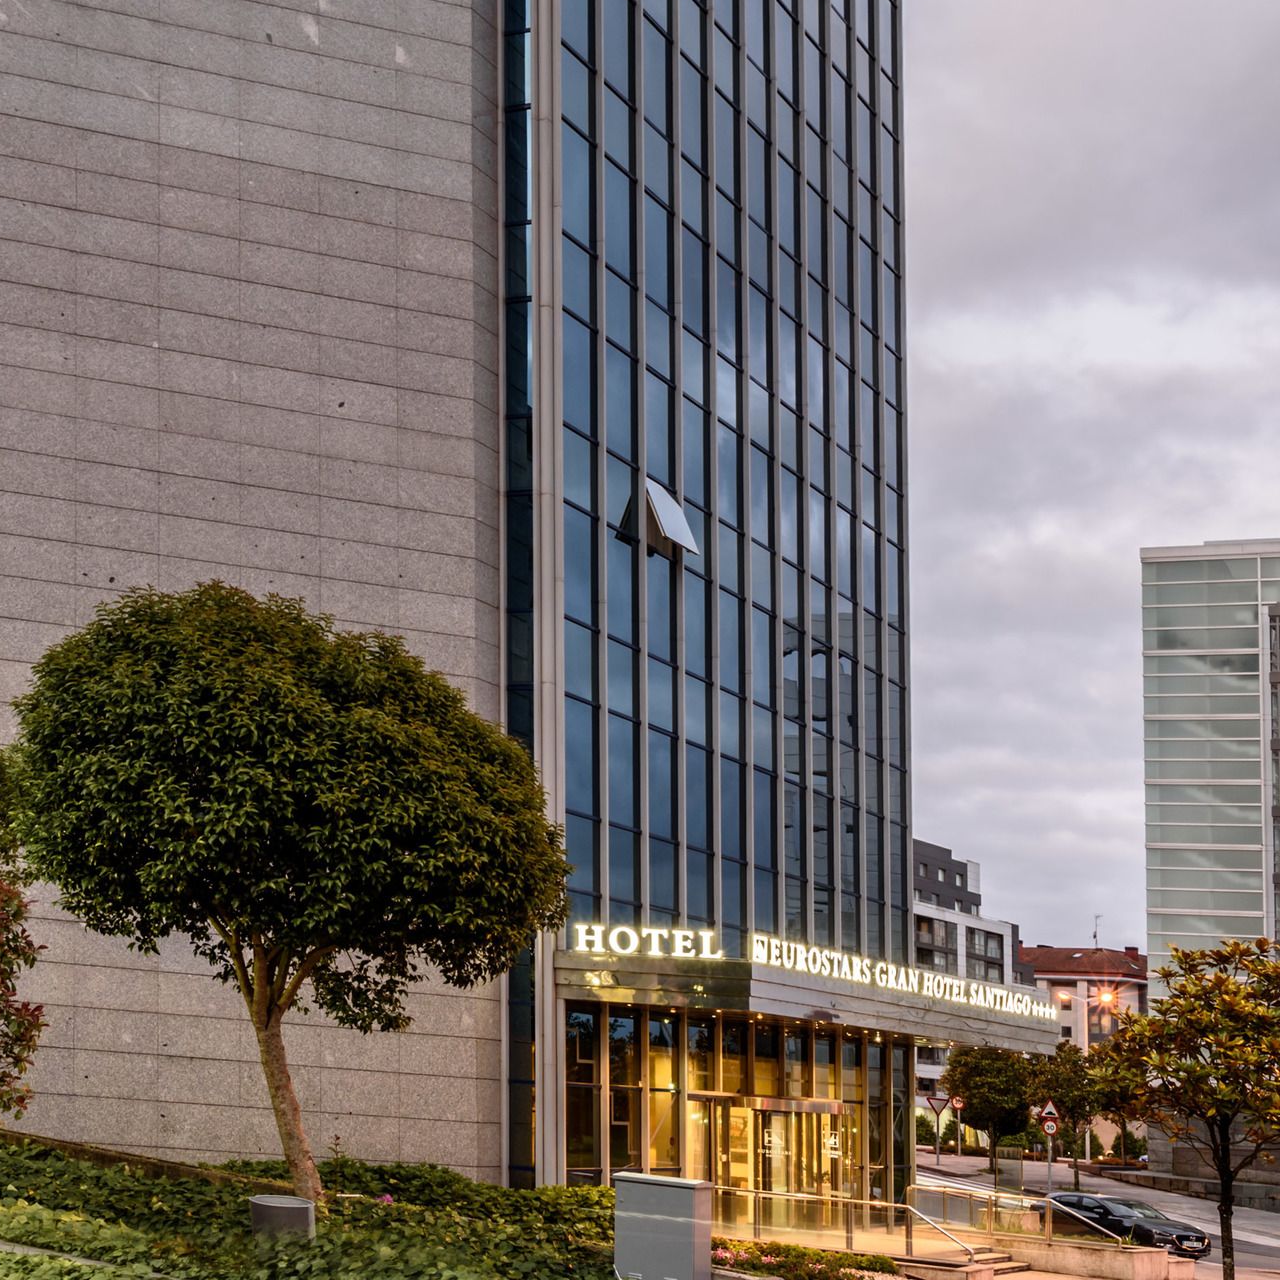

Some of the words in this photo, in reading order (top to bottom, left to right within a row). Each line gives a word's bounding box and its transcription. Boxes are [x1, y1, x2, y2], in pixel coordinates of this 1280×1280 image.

[574, 924, 723, 959] HOTEL
[769, 938, 871, 984] EUROSTARS
[875, 961, 920, 993] GRAN
[922, 972, 967, 1003] HOTEL
[969, 982, 1032, 1017] SANTIAGO
